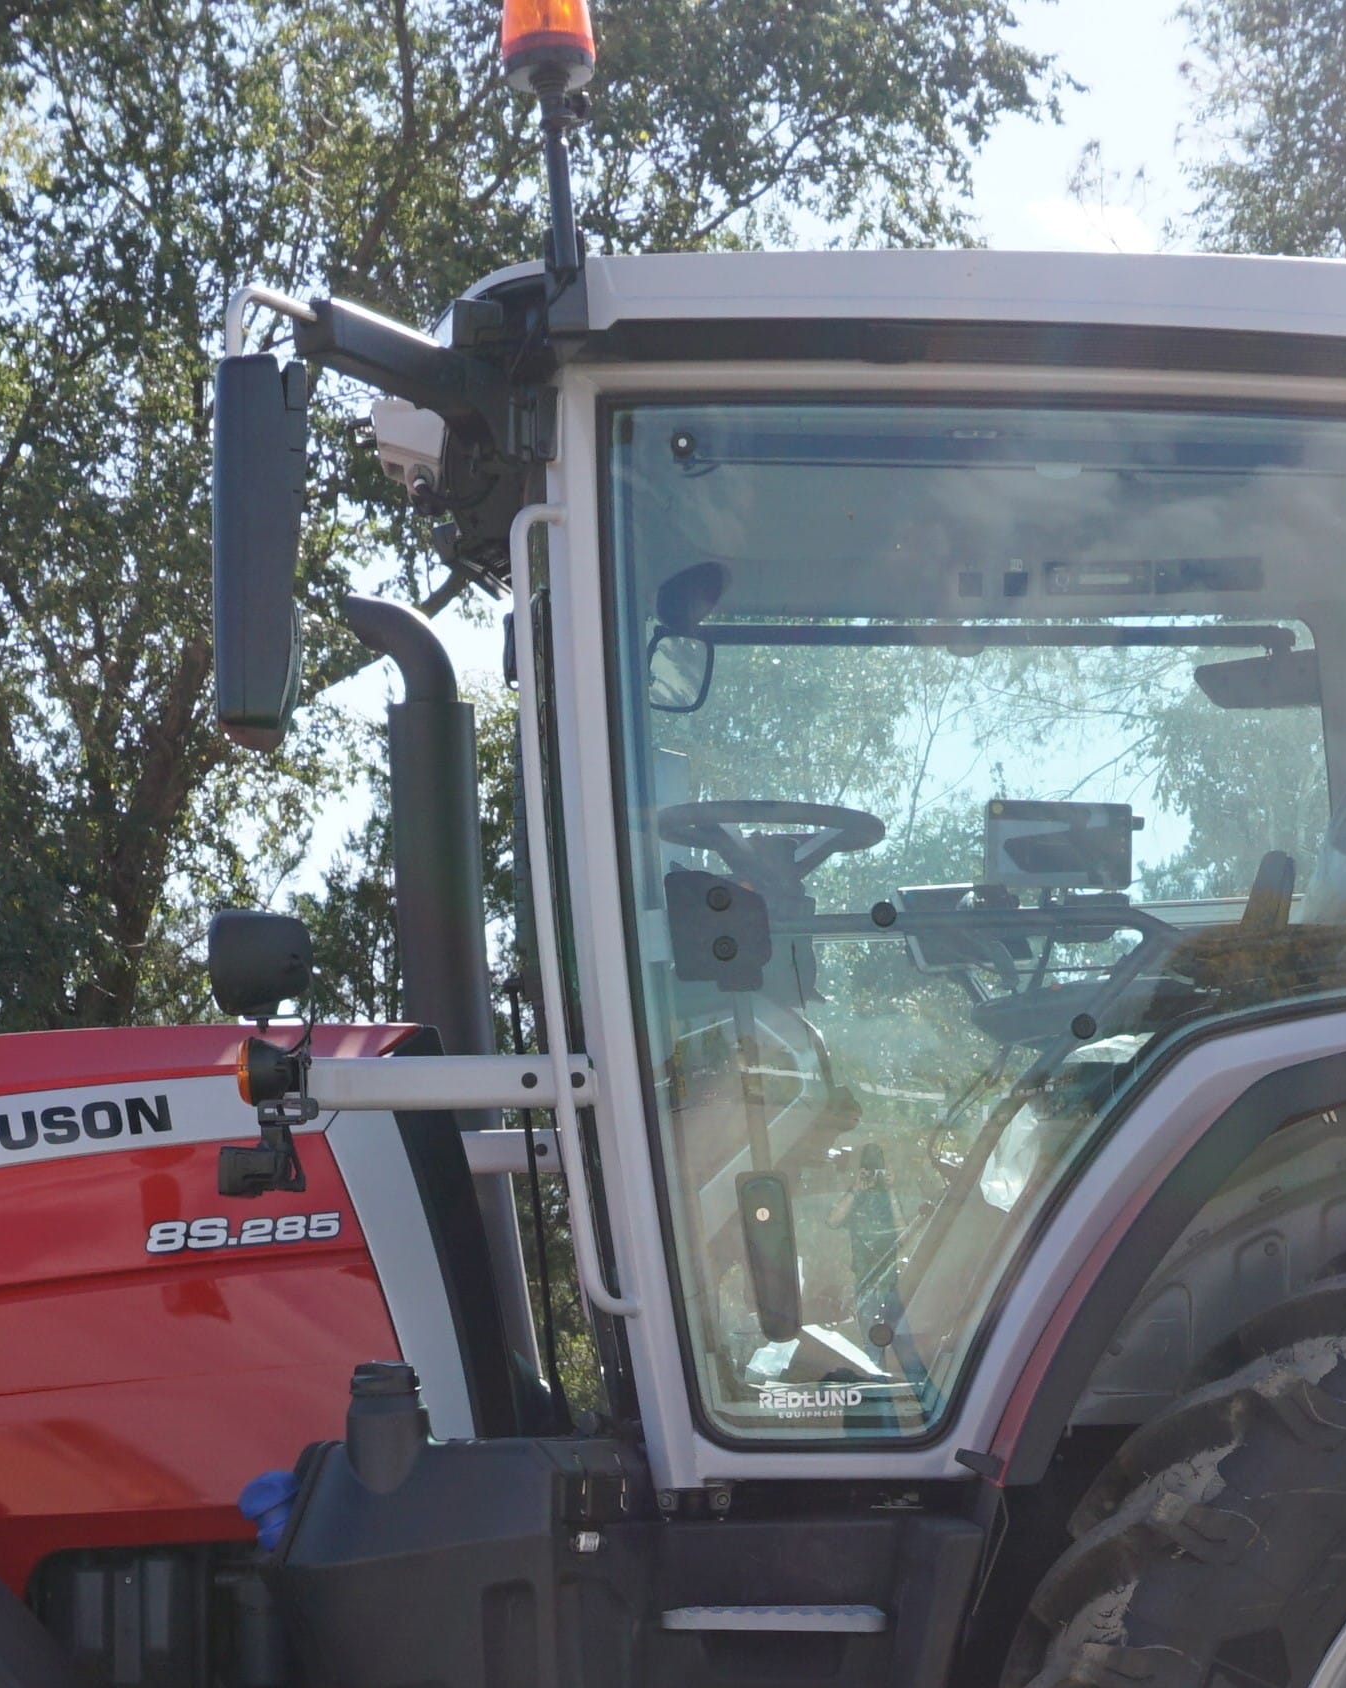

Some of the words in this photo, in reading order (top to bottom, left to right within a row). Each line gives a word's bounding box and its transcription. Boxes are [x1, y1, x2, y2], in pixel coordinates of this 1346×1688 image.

[144, 1210, 341, 1254] 8S.285
[758, 1390, 862, 1409] REDLUND
[778, 1410, 844, 1419] EQUIPMENT
